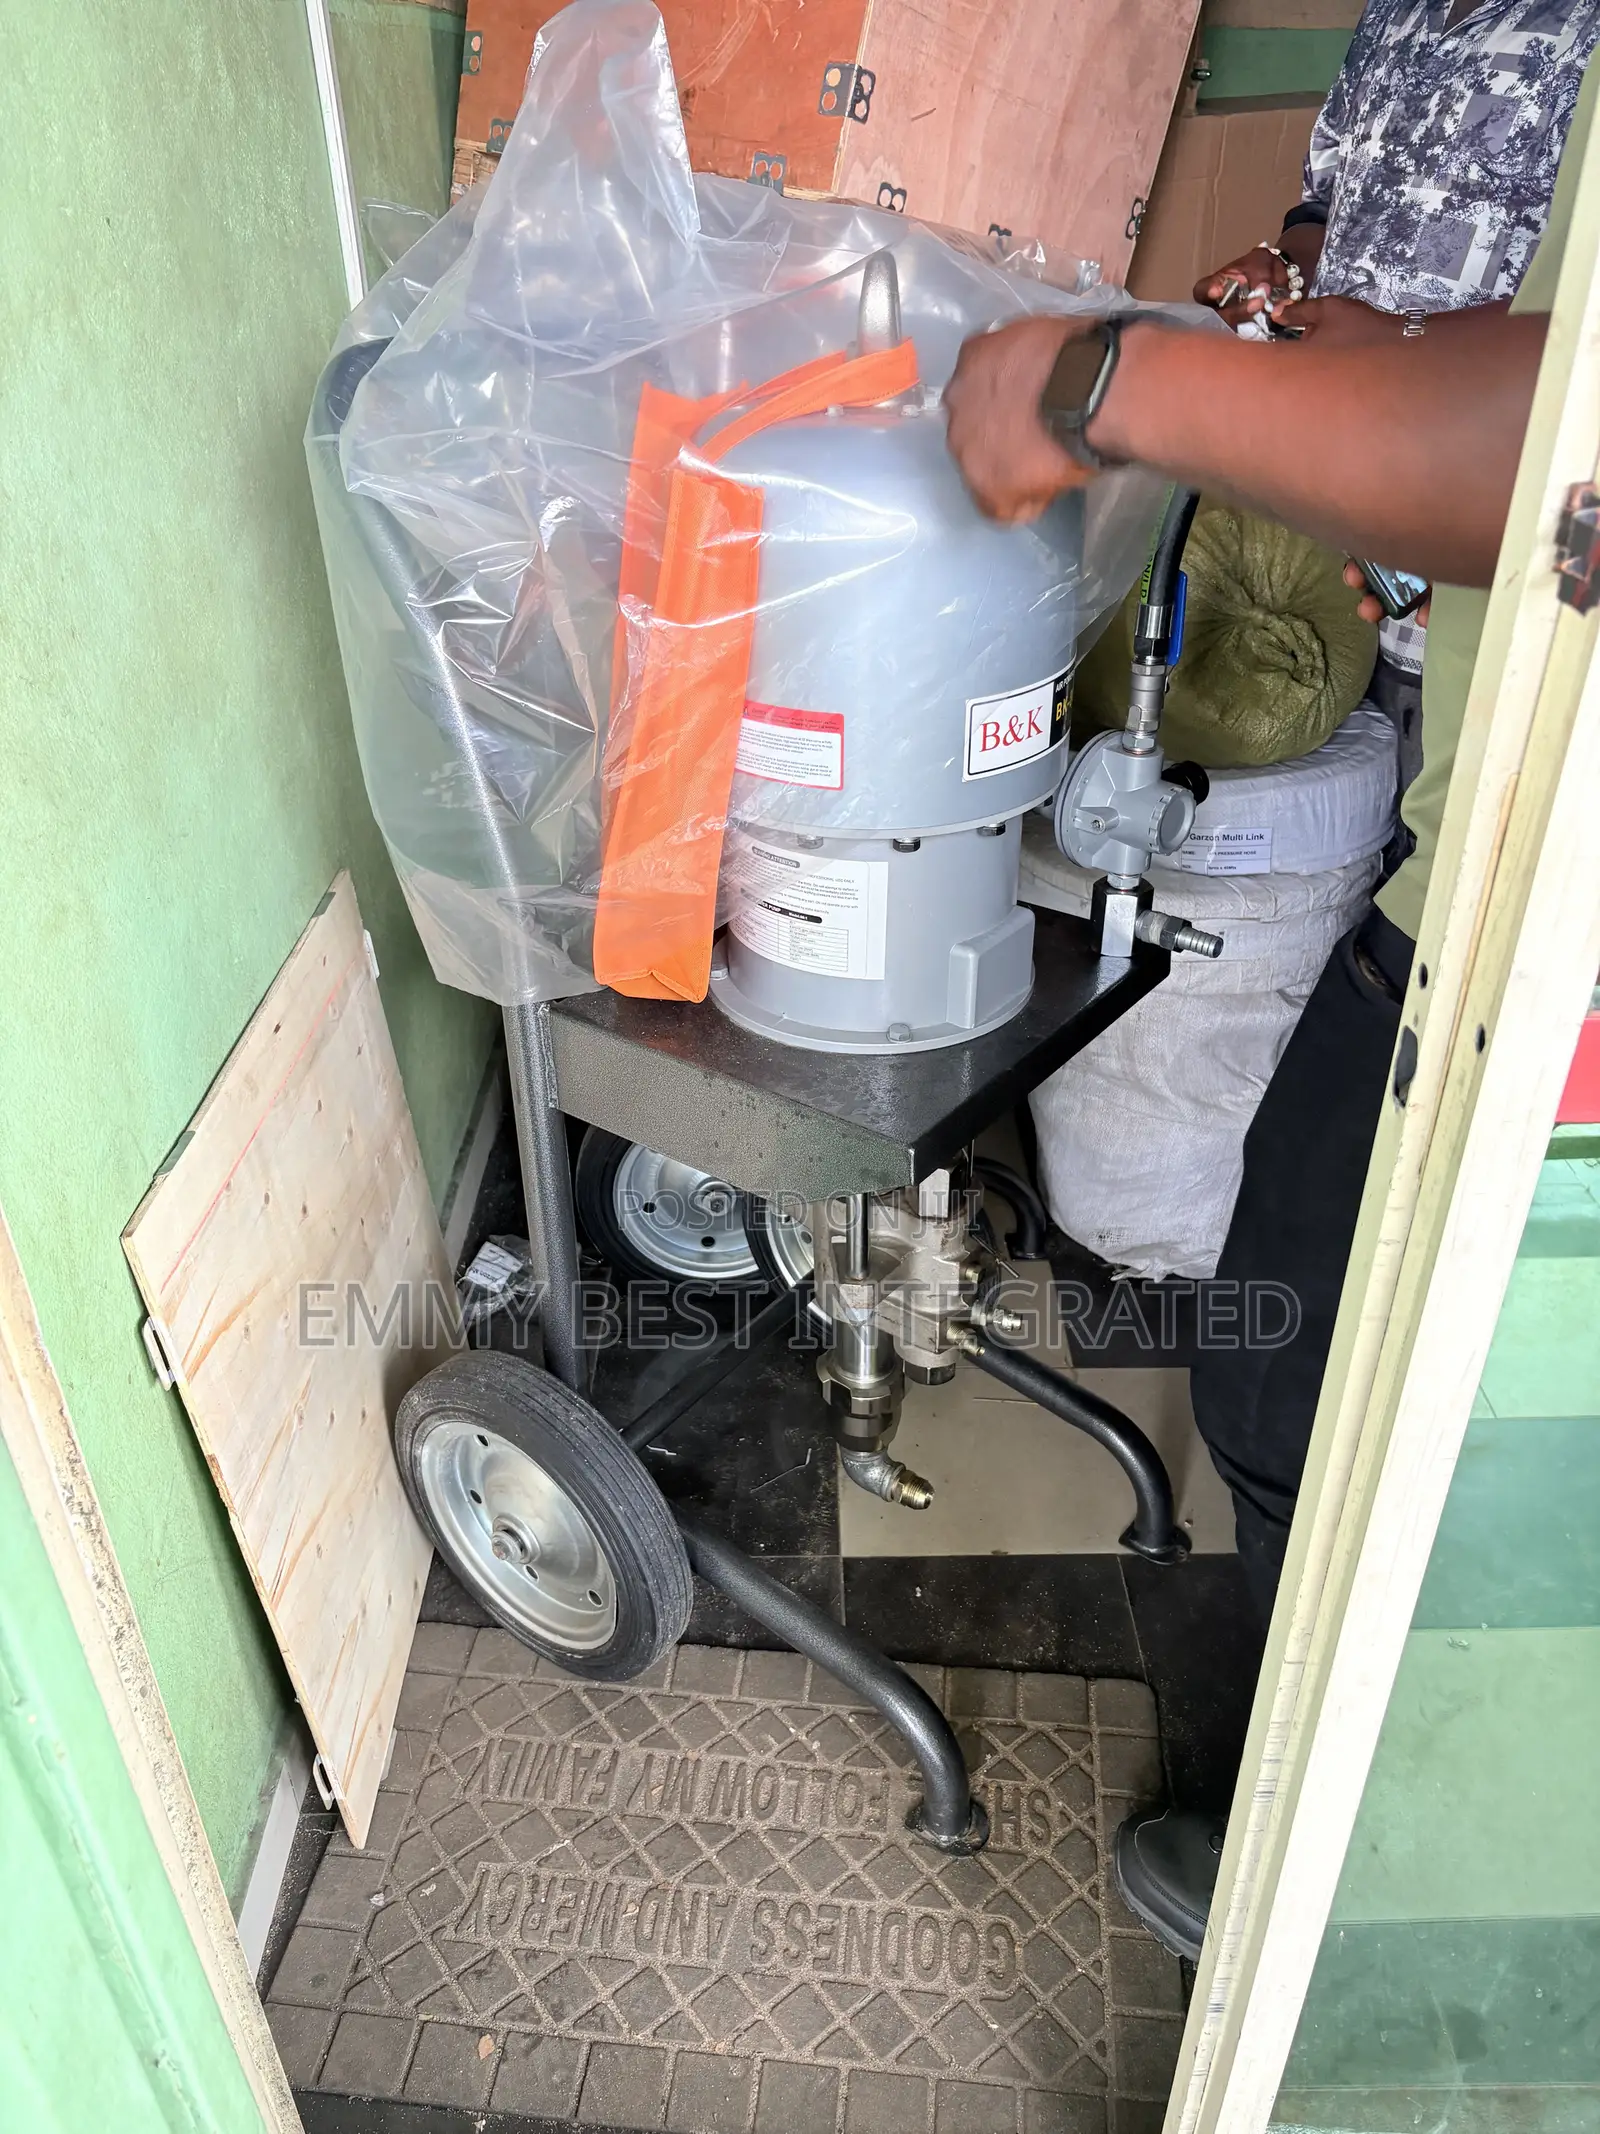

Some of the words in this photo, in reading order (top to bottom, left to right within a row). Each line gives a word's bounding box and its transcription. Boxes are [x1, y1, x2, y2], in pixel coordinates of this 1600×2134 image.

[979, 705, 1043, 753] B&K
[1189, 833, 1220, 842] Garzon
[1222, 833, 1244, 842] Multi
[1245, 833, 1265, 841] Link
[462, 1737, 619, 1805] FAMILY
[627, 1752, 699, 1818] MY
[708, 1759, 890, 1835] FOLLOW
[454, 1867, 625, 1952] MERCY
[634, 1885, 738, 1962] AND
[750, 1898, 1018, 1993] GOODNESS
